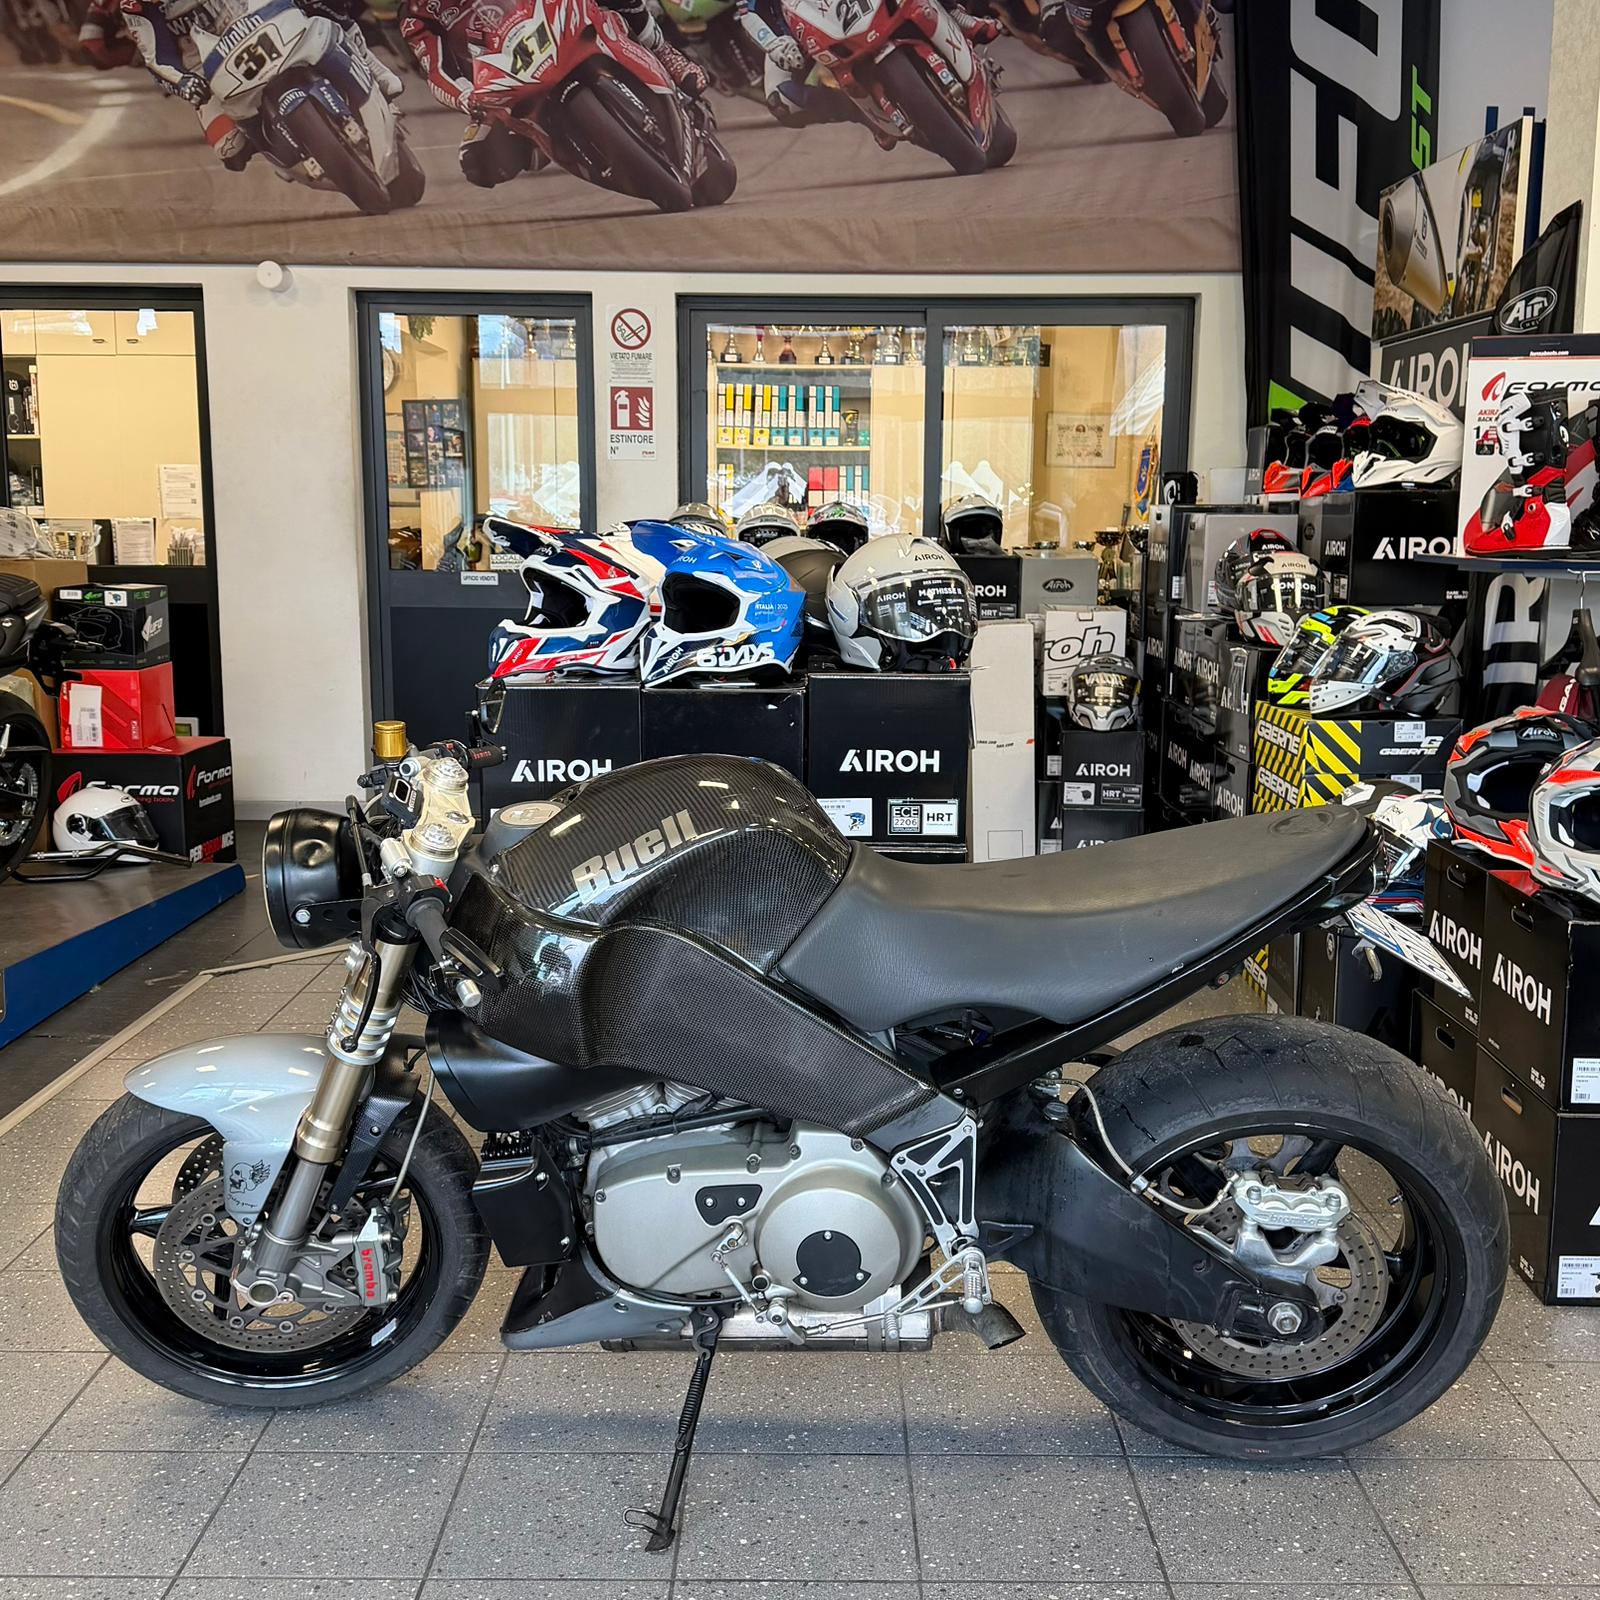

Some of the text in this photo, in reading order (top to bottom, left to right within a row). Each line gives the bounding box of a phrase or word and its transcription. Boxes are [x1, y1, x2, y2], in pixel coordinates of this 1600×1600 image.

[216, 14, 264, 58] WinWin
[511, 21, 552, 76] 41
[610, 434, 653, 443] ESTINTORE
[914, 553, 945, 561] AIROH
[1325, 540, 1346, 557] AIROH
[877, 592, 906, 602] AIROH
[974, 585, 1007, 597] ROH
[981, 609, 997, 617] HRT
[839, 749, 941, 773] AIROH
[197, 766, 232, 787] Forma
[511, 759, 612, 783] AIROH
[1076, 763, 1131, 777] AIROH
[1102, 790, 1121, 798] HRT
[1217, 787, 1244, 817] AIROH
[894, 807, 918, 816] ECE
[926, 813, 953, 822] HRT
[894, 818, 917, 826] 2206
[572, 809, 699, 906] Buell
[1429, 910, 1482, 970] AIROH
[1492, 953, 1552, 1026] AIROH
[361, 1248, 378, 1299] brembo
